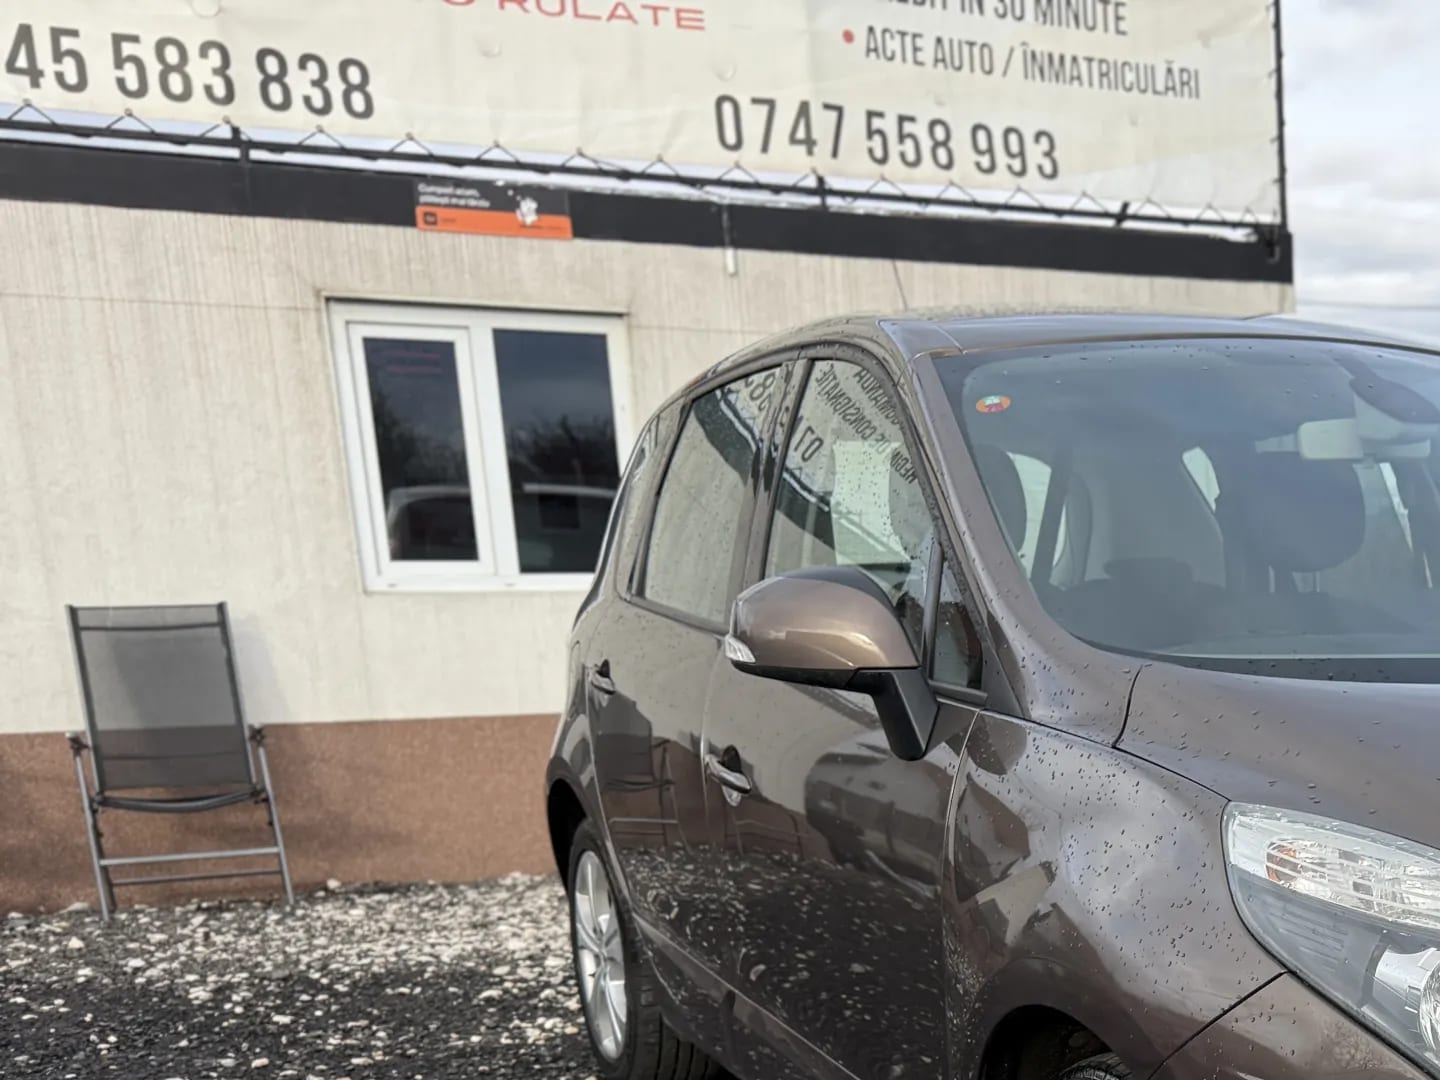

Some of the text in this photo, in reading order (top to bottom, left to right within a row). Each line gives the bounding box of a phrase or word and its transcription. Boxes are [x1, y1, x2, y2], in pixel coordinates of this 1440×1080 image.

[1034, 0, 1128, 36] MINUTE
[5, 23, 374, 120] 45 583 838
[865, 25, 926, 67] ACTE
[933, 36, 994, 76] AUTO
[1021, 42, 1201, 100] ÎNMATRICULĂRI
[715, 94, 1059, 180] 0747 558 993
